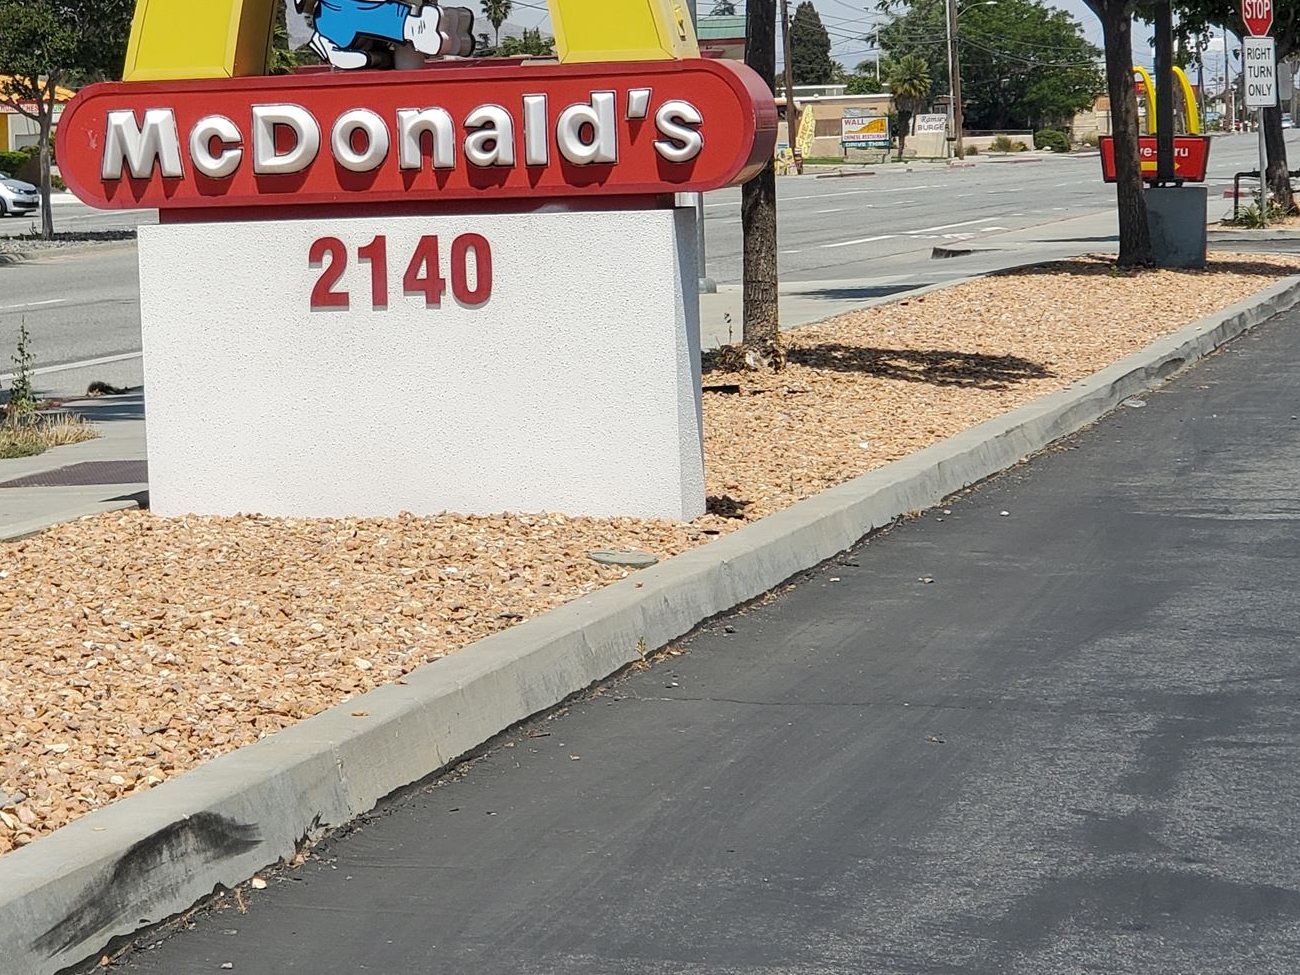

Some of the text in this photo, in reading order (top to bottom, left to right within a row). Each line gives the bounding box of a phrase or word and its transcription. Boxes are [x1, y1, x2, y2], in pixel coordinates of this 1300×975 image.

[1246, 47, 1271, 61] RIGHT
[1248, 65, 1273, 78] TURN
[1248, 83, 1273, 97] ONLY
[844, 118, 866, 126] WALL
[100, 87, 704, 181] McDonald's
[308, 232, 493, 310] 2140
